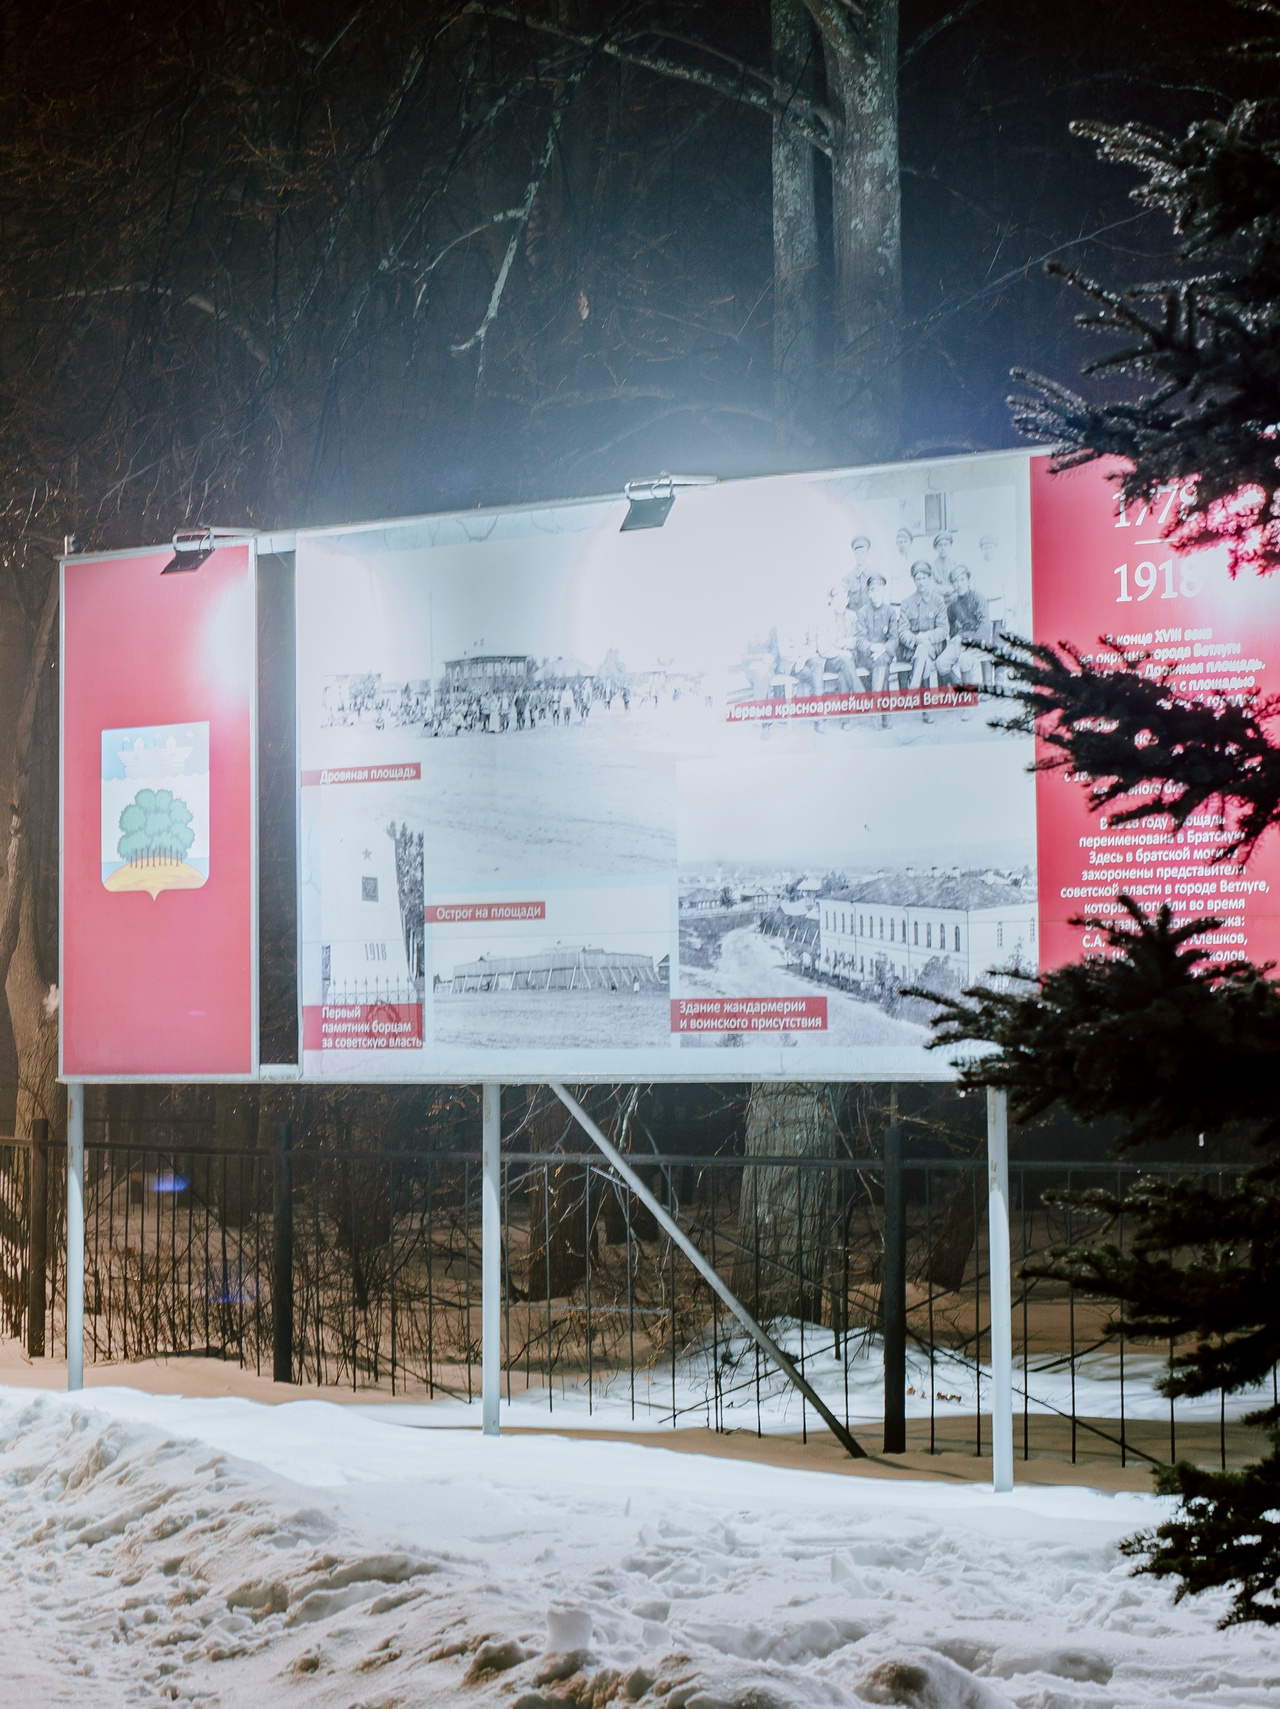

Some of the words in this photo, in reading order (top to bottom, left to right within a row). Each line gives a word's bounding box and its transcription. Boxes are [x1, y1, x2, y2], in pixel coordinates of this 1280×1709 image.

[1114, 559, 1203, 602] 1918
[1117, 633, 1152, 646] конце
[1155, 628, 1182, 643] XVIII
[1193, 642, 1241, 658] Ветлуги
[1189, 676, 1255, 691] площадью
[726, 703, 772, 720] Первые
[775, 691, 873, 716] красноармейцы
[877, 694, 919, 712] города
[923, 691, 972, 708] Ветлуги
[320, 769, 368, 785] Дровяная
[371, 766, 416, 781] площадь
[1100, 816, 1108, 830] В
[1142, 816, 1168, 830] году
[1079, 831, 1174, 849] переименована
[1177, 833, 1184, 843] в
[1089, 850, 1123, 865] Здесь
[1126, 852, 1133, 862] в
[1136, 847, 1190, 865] братской
[1193, 847, 1238, 860] могие
[1082, 867, 1153, 882] захоронены
[1060, 882, 1119, 898] советской
[1165, 883, 1172, 894] в
[1175, 881, 1217, 896] городе
[1220, 879, 1270, 894] Ветлуге,
[436, 906, 472, 922] Острог
[476, 908, 488, 918] на
[491, 904, 541, 920] площади
[1084, 901, 1129, 916] которы
[1190, 899, 1204, 910] во
[1207, 898, 1245, 912] время
[364, 943, 387, 961] 1918
[322, 1006, 361, 1020] Первый
[679, 1001, 720, 1015] Здание
[723, 1000, 806, 1015] жандармерии
[322, 1022, 370, 1034] памятник
[372, 1019, 411, 1036] борцам
[680, 1020, 687, 1029] и
[690, 1018, 748, 1030] воинского
[751, 1017, 822, 1030] присутствия
[322, 1037, 332, 1048] за
[335, 1037, 386, 1049] советскую
